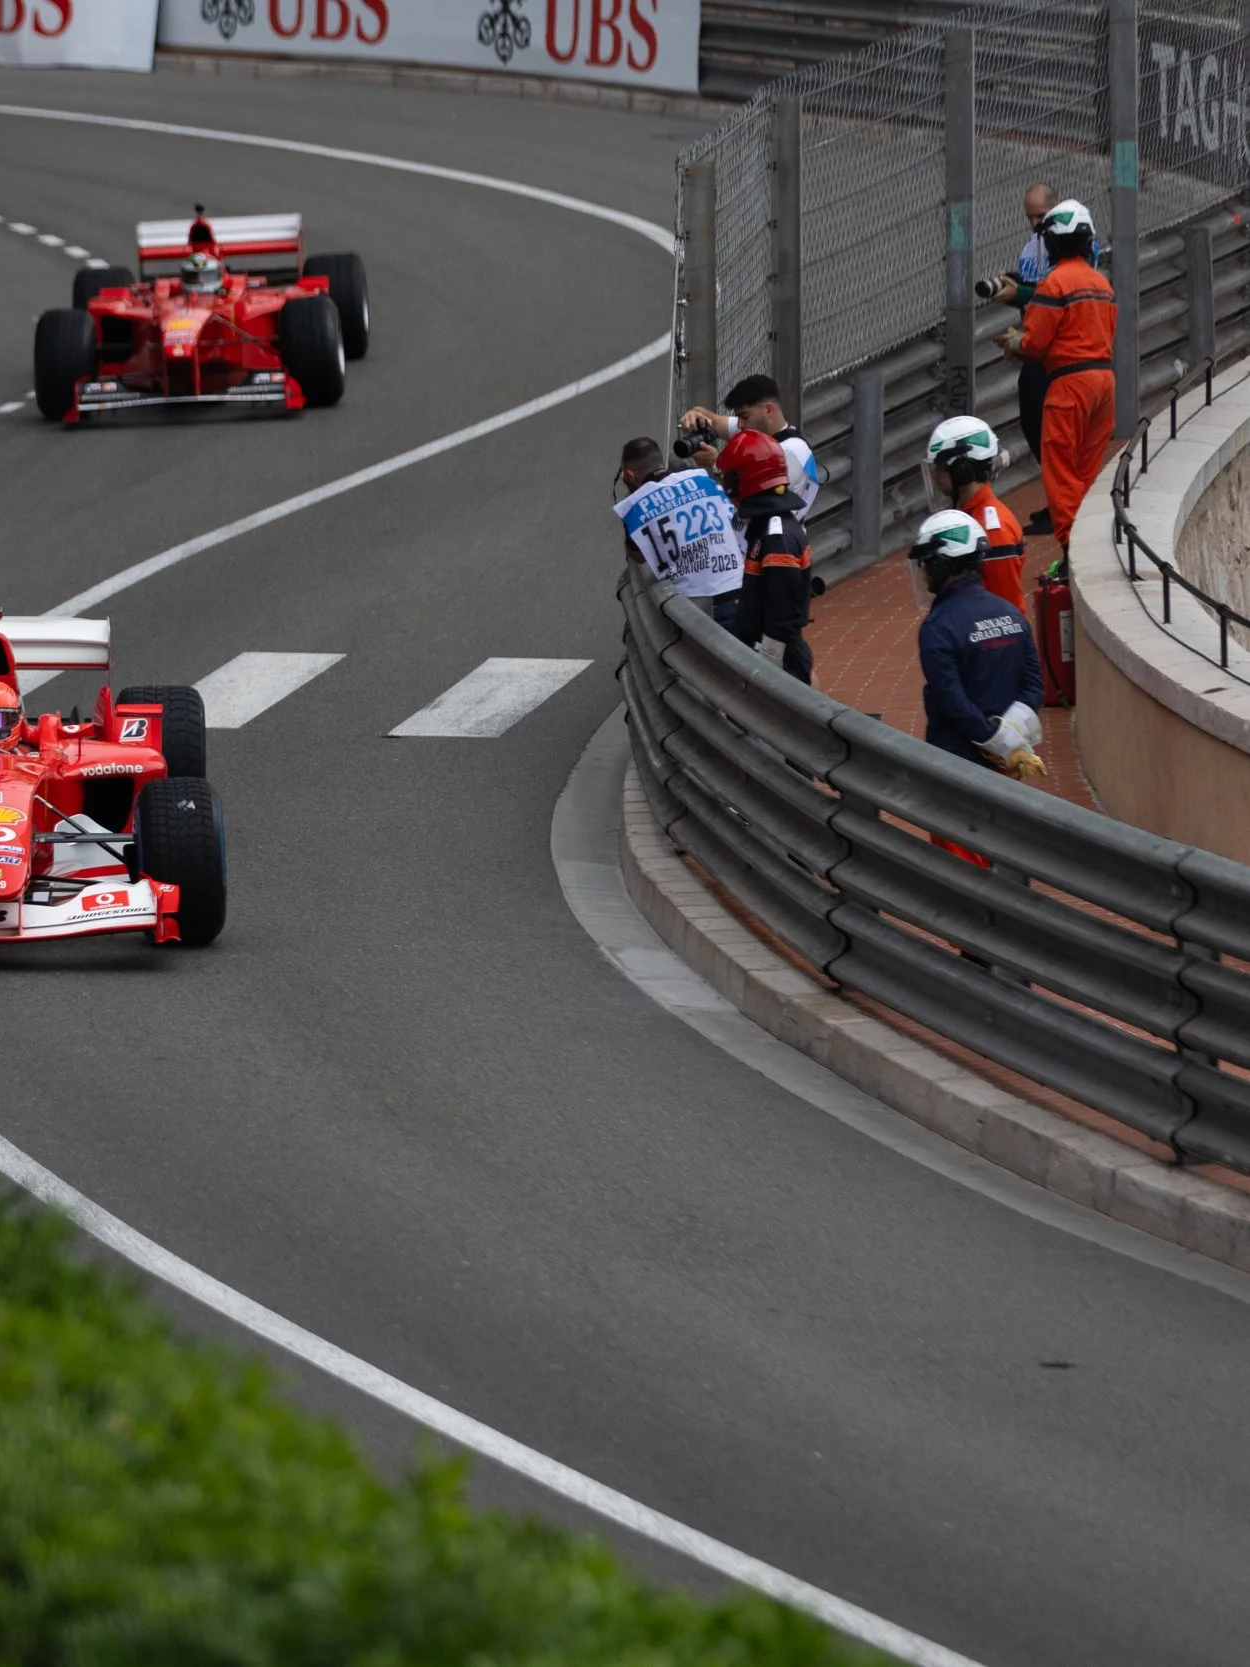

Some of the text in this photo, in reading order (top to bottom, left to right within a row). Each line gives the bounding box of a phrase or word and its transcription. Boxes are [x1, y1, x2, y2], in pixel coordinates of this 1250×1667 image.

[546, 0, 658, 74] UBS
[638, 479, 699, 513] PHOTO
[638, 489, 708, 524] PITLANE/PISTE
[676, 502, 725, 542] 223
[641, 516, 681, 573] 15
[681, 533, 726, 556] GRAND PRIX
[711, 553, 738, 574] 2026
[969, 623, 1024, 643] GRAND PRIX
[974, 615, 1012, 631] MONACO
[80, 762, 144, 777] vodafone
